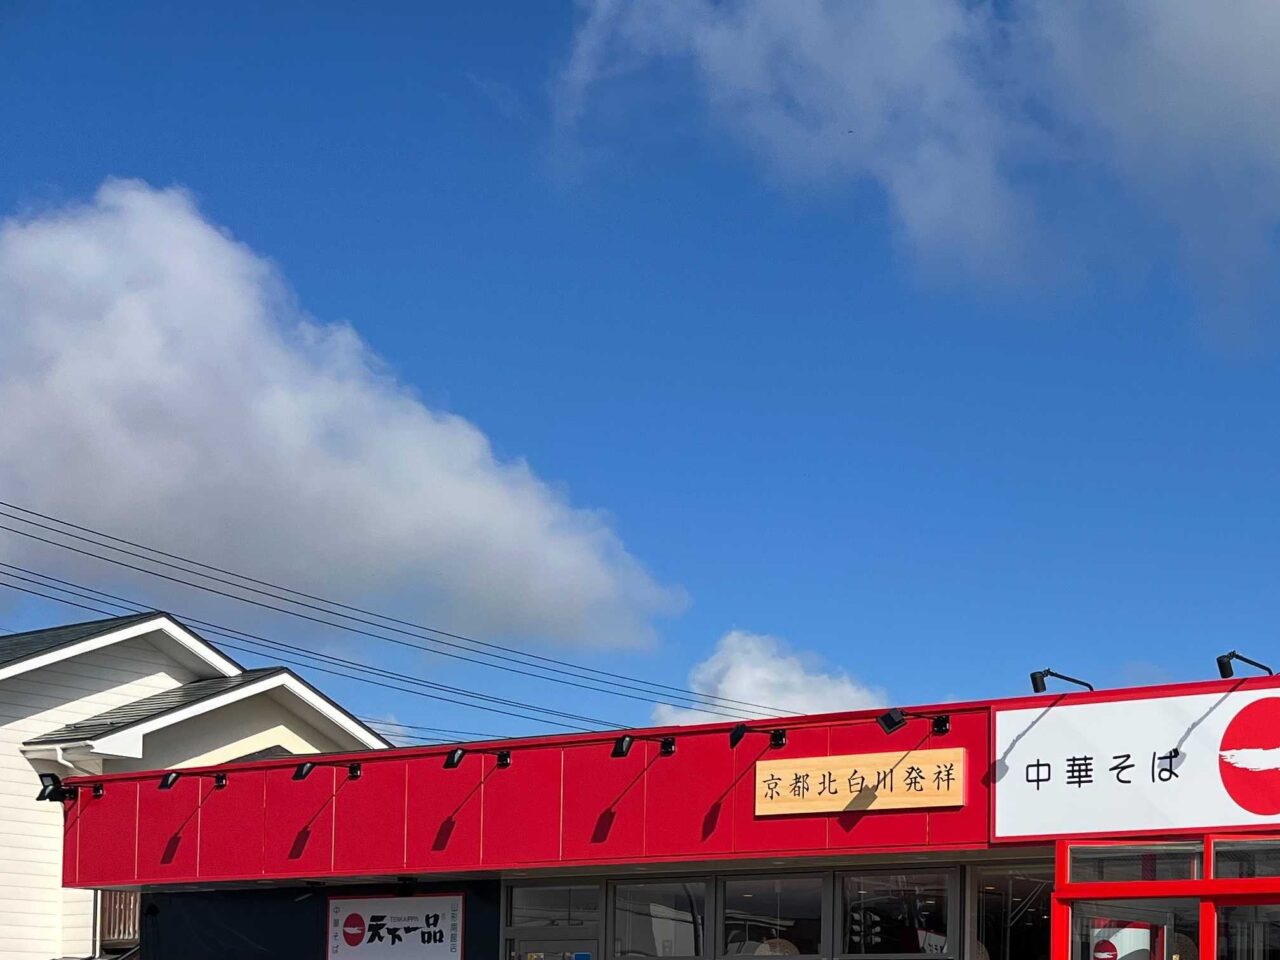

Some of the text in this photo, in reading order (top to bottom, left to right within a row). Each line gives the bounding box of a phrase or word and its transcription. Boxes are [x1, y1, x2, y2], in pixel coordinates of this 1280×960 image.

[762, 763, 956, 800] 京都北白川発祥
[1025, 749, 1180, 791] 中華そば
[366, 913, 444, 945] 天下一品
